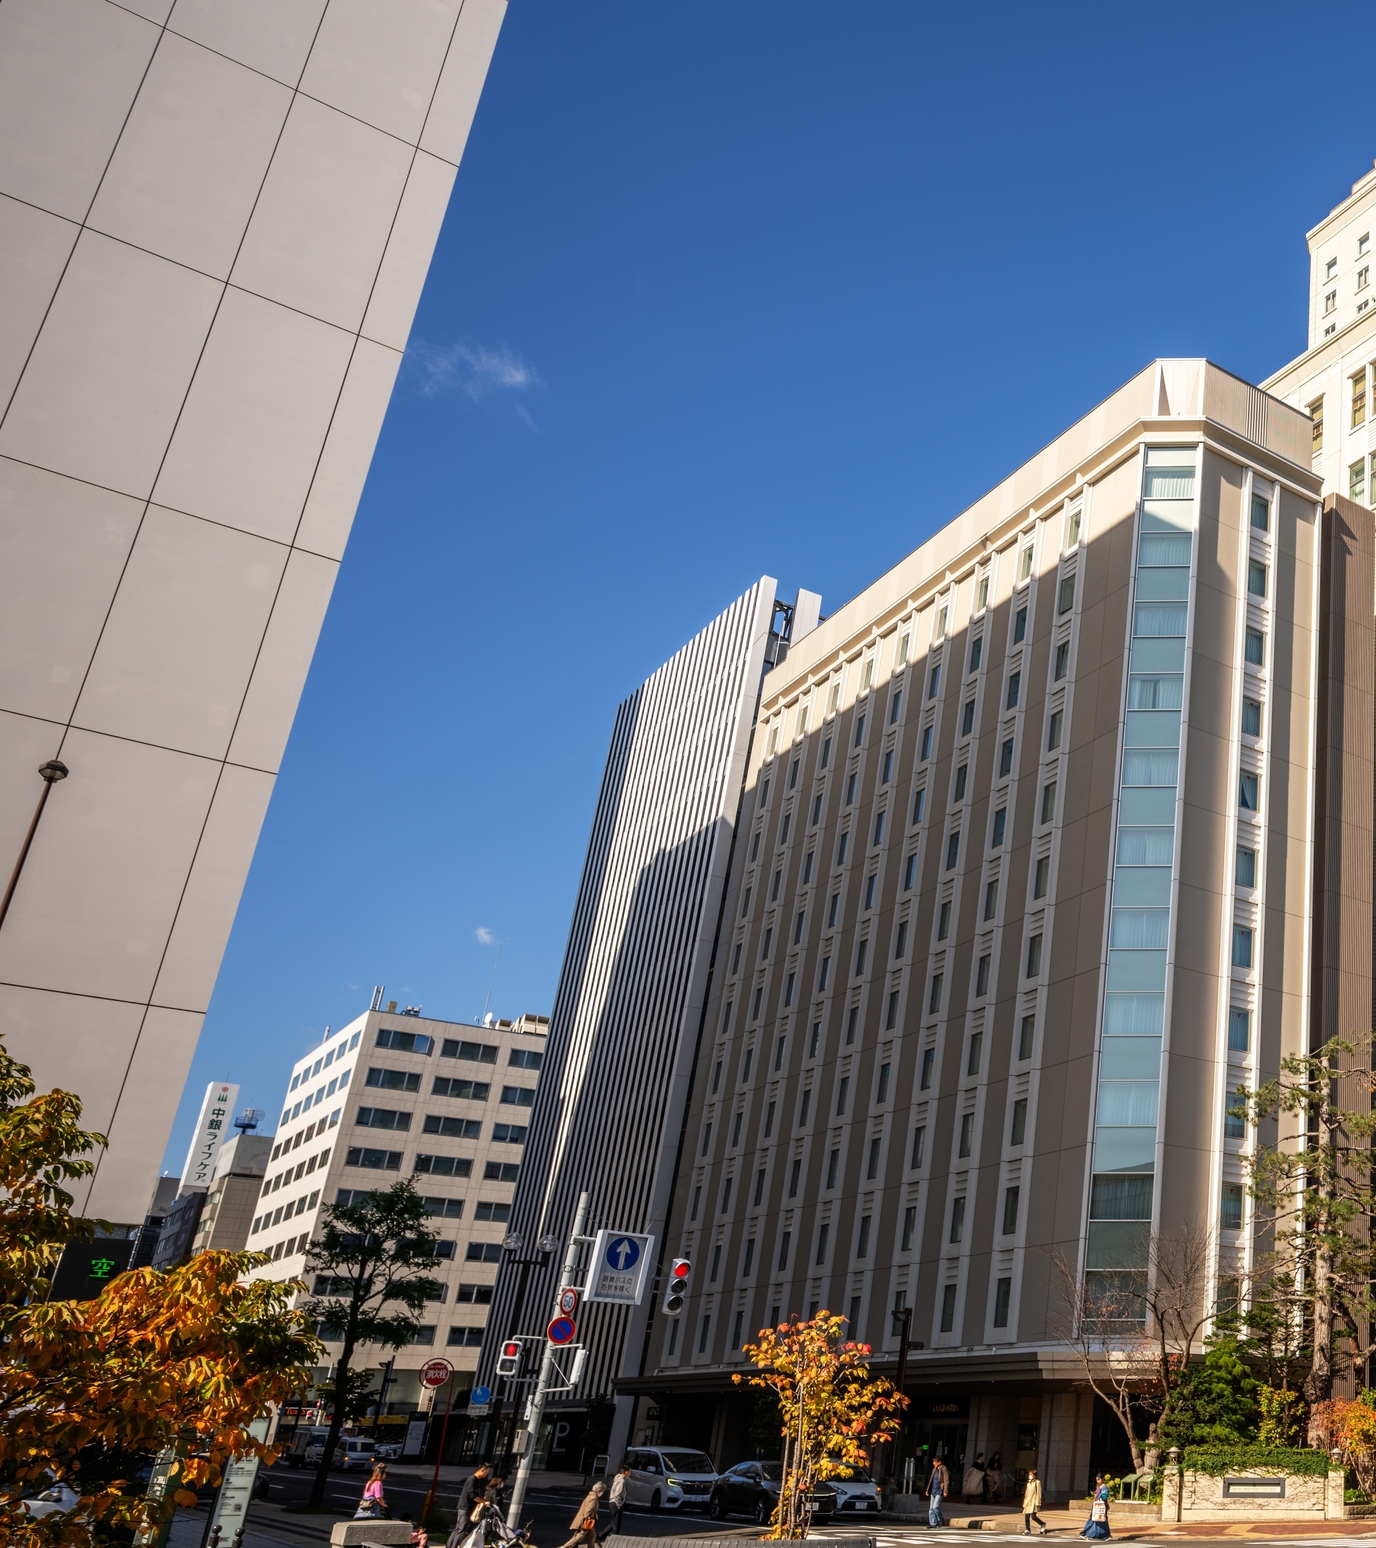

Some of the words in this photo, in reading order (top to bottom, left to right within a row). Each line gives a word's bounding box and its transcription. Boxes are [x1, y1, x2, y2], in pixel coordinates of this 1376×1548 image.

[194, 1107, 226, 1182] 中銀ライフケア
[88, 1258, 115, 1278] 空
[563, 1295, 574, 1309] 50
[426, 1369, 447, 1379] 消火栓
[552, 1421, 570, 1449] P
